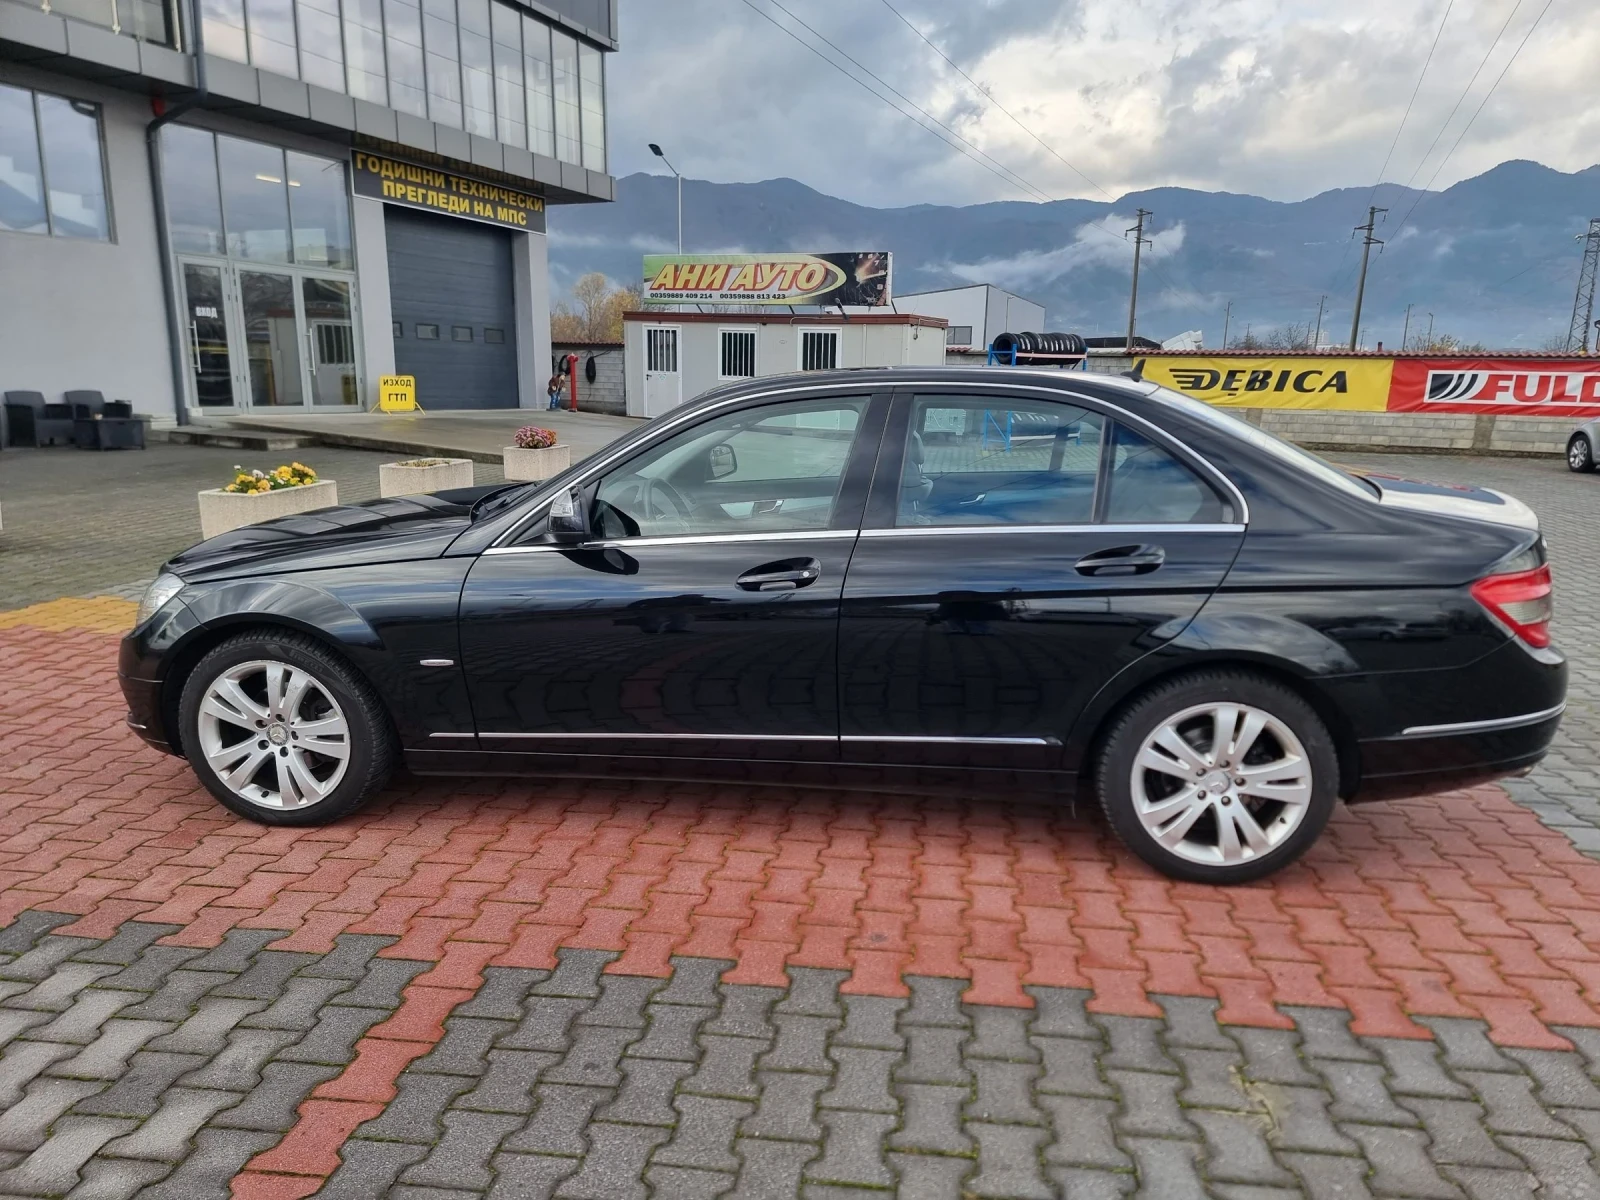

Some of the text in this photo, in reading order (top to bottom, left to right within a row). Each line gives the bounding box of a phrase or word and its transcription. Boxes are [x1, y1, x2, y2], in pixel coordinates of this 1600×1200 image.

[355, 153, 445, 188] ГОДИШНИ
[449, 177, 543, 212] ТЕХНИЧЕСКИ
[382, 180, 527, 226] ПРЕГЛЕДИ НА МПС
[649, 262, 828, 292] АНИ АУТО
[383, 378, 412, 388] ИЗХОД
[388, 393, 407, 402] ГТП
